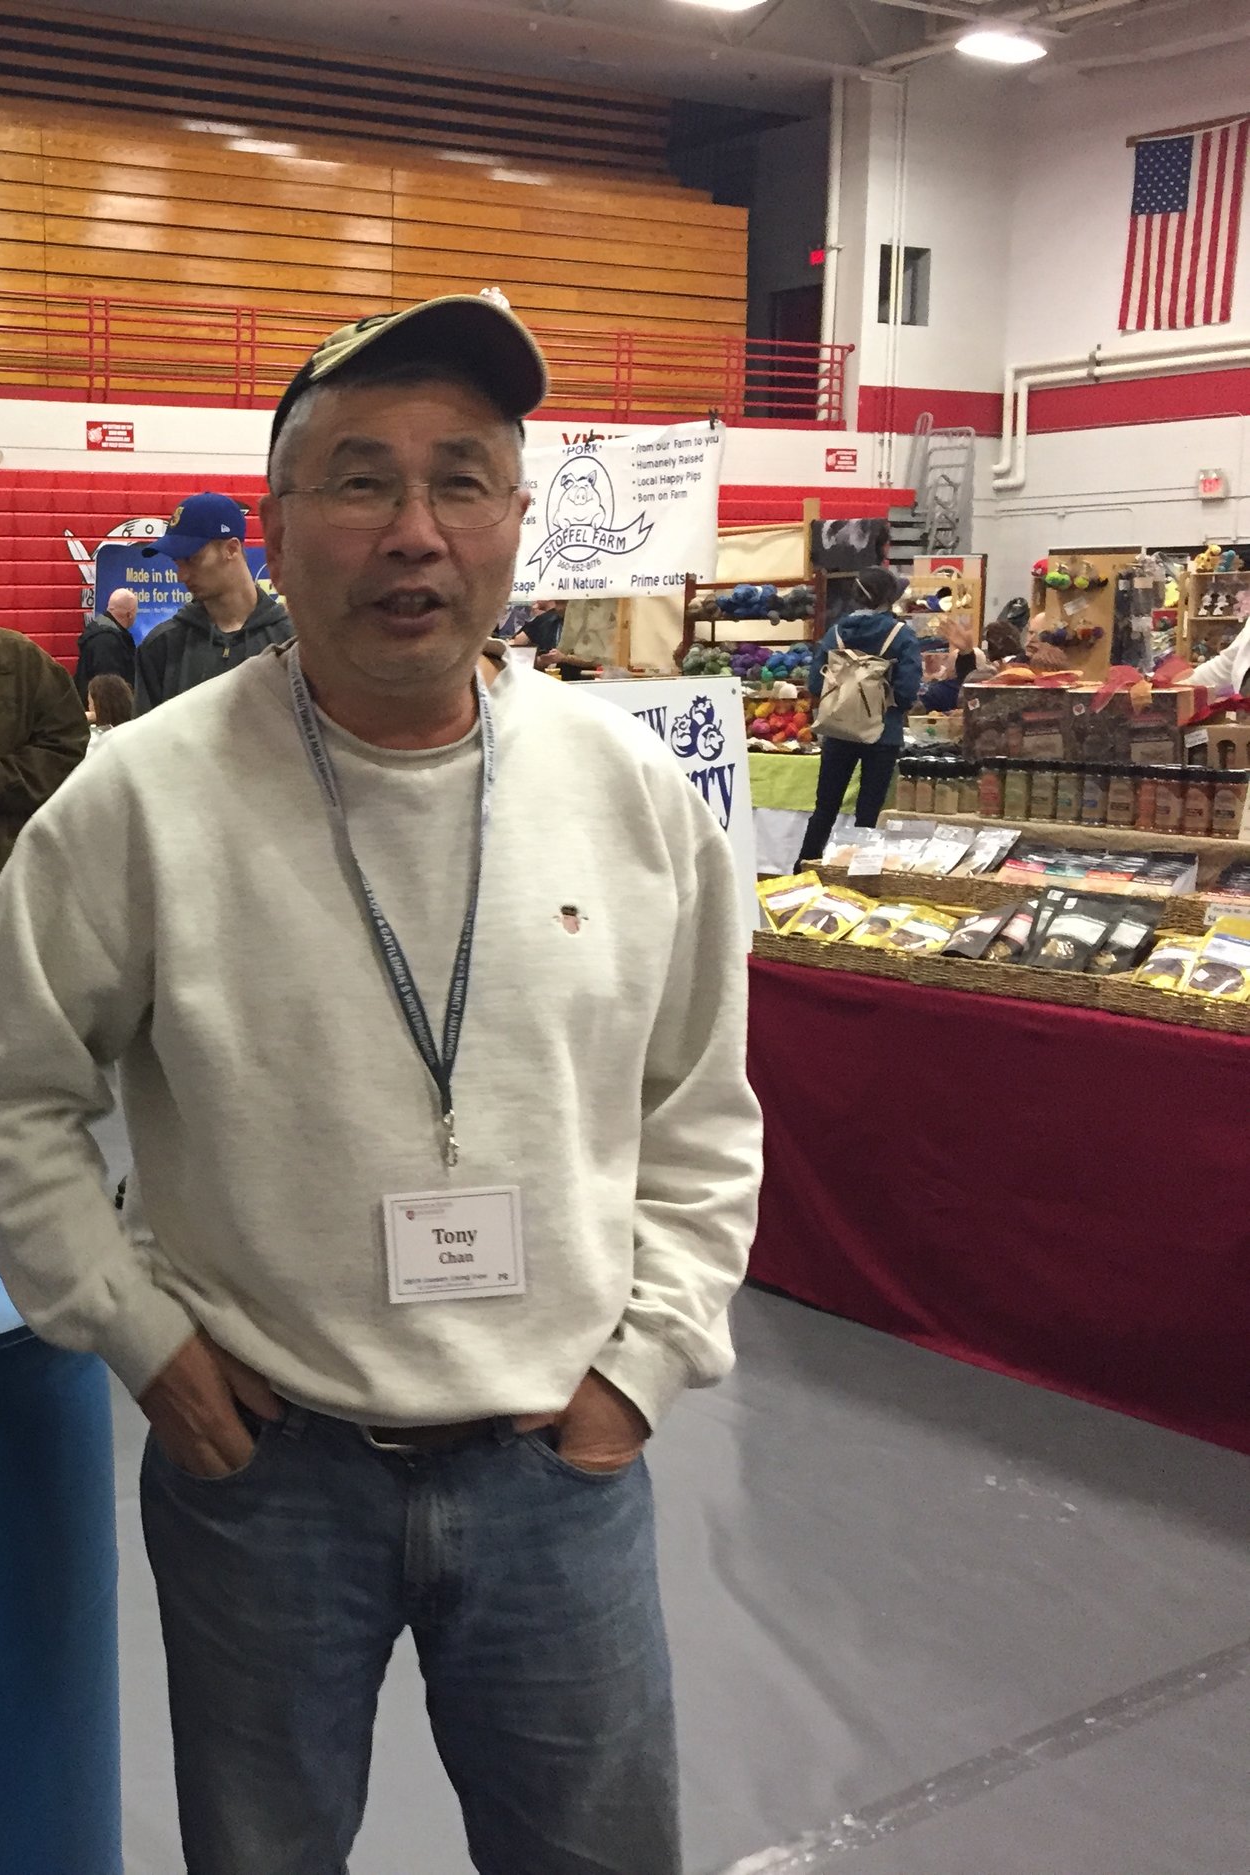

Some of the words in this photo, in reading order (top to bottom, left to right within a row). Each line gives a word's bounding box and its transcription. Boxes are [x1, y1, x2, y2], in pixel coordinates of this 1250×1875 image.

[567, 444, 597, 456] PORK
[656, 441, 670, 451] our
[673, 437, 692, 449] Farm
[694, 436, 703, 446] to
[705, 434, 719, 447] you
[636, 456, 676, 470] Humanely
[678, 453, 704, 465] Raised
[637, 476, 658, 486] Local
[659, 474, 684, 486] Happy
[686, 471, 701, 482] Pigs
[638, 493, 655, 503] Born
[657, 491, 668, 500] on
[670, 489, 687, 500] Farm
[544, 529, 588, 559] STOFFEL
[592, 530, 626, 550] FARM
[125, 567, 150, 583] Made
[151, 567, 163, 583] in
[630, 574, 660, 587] Prime
[662, 572, 686, 586] cuts
[557, 577, 570, 591] All
[572, 576, 607, 589] Natural
[152, 587, 168, 603] for
[171, 587, 194, 604] the
[452, 980, 465, 1012] LIVING
[431, 1228, 478, 1247] Tony
[439, 1251, 474, 1265] Chan
